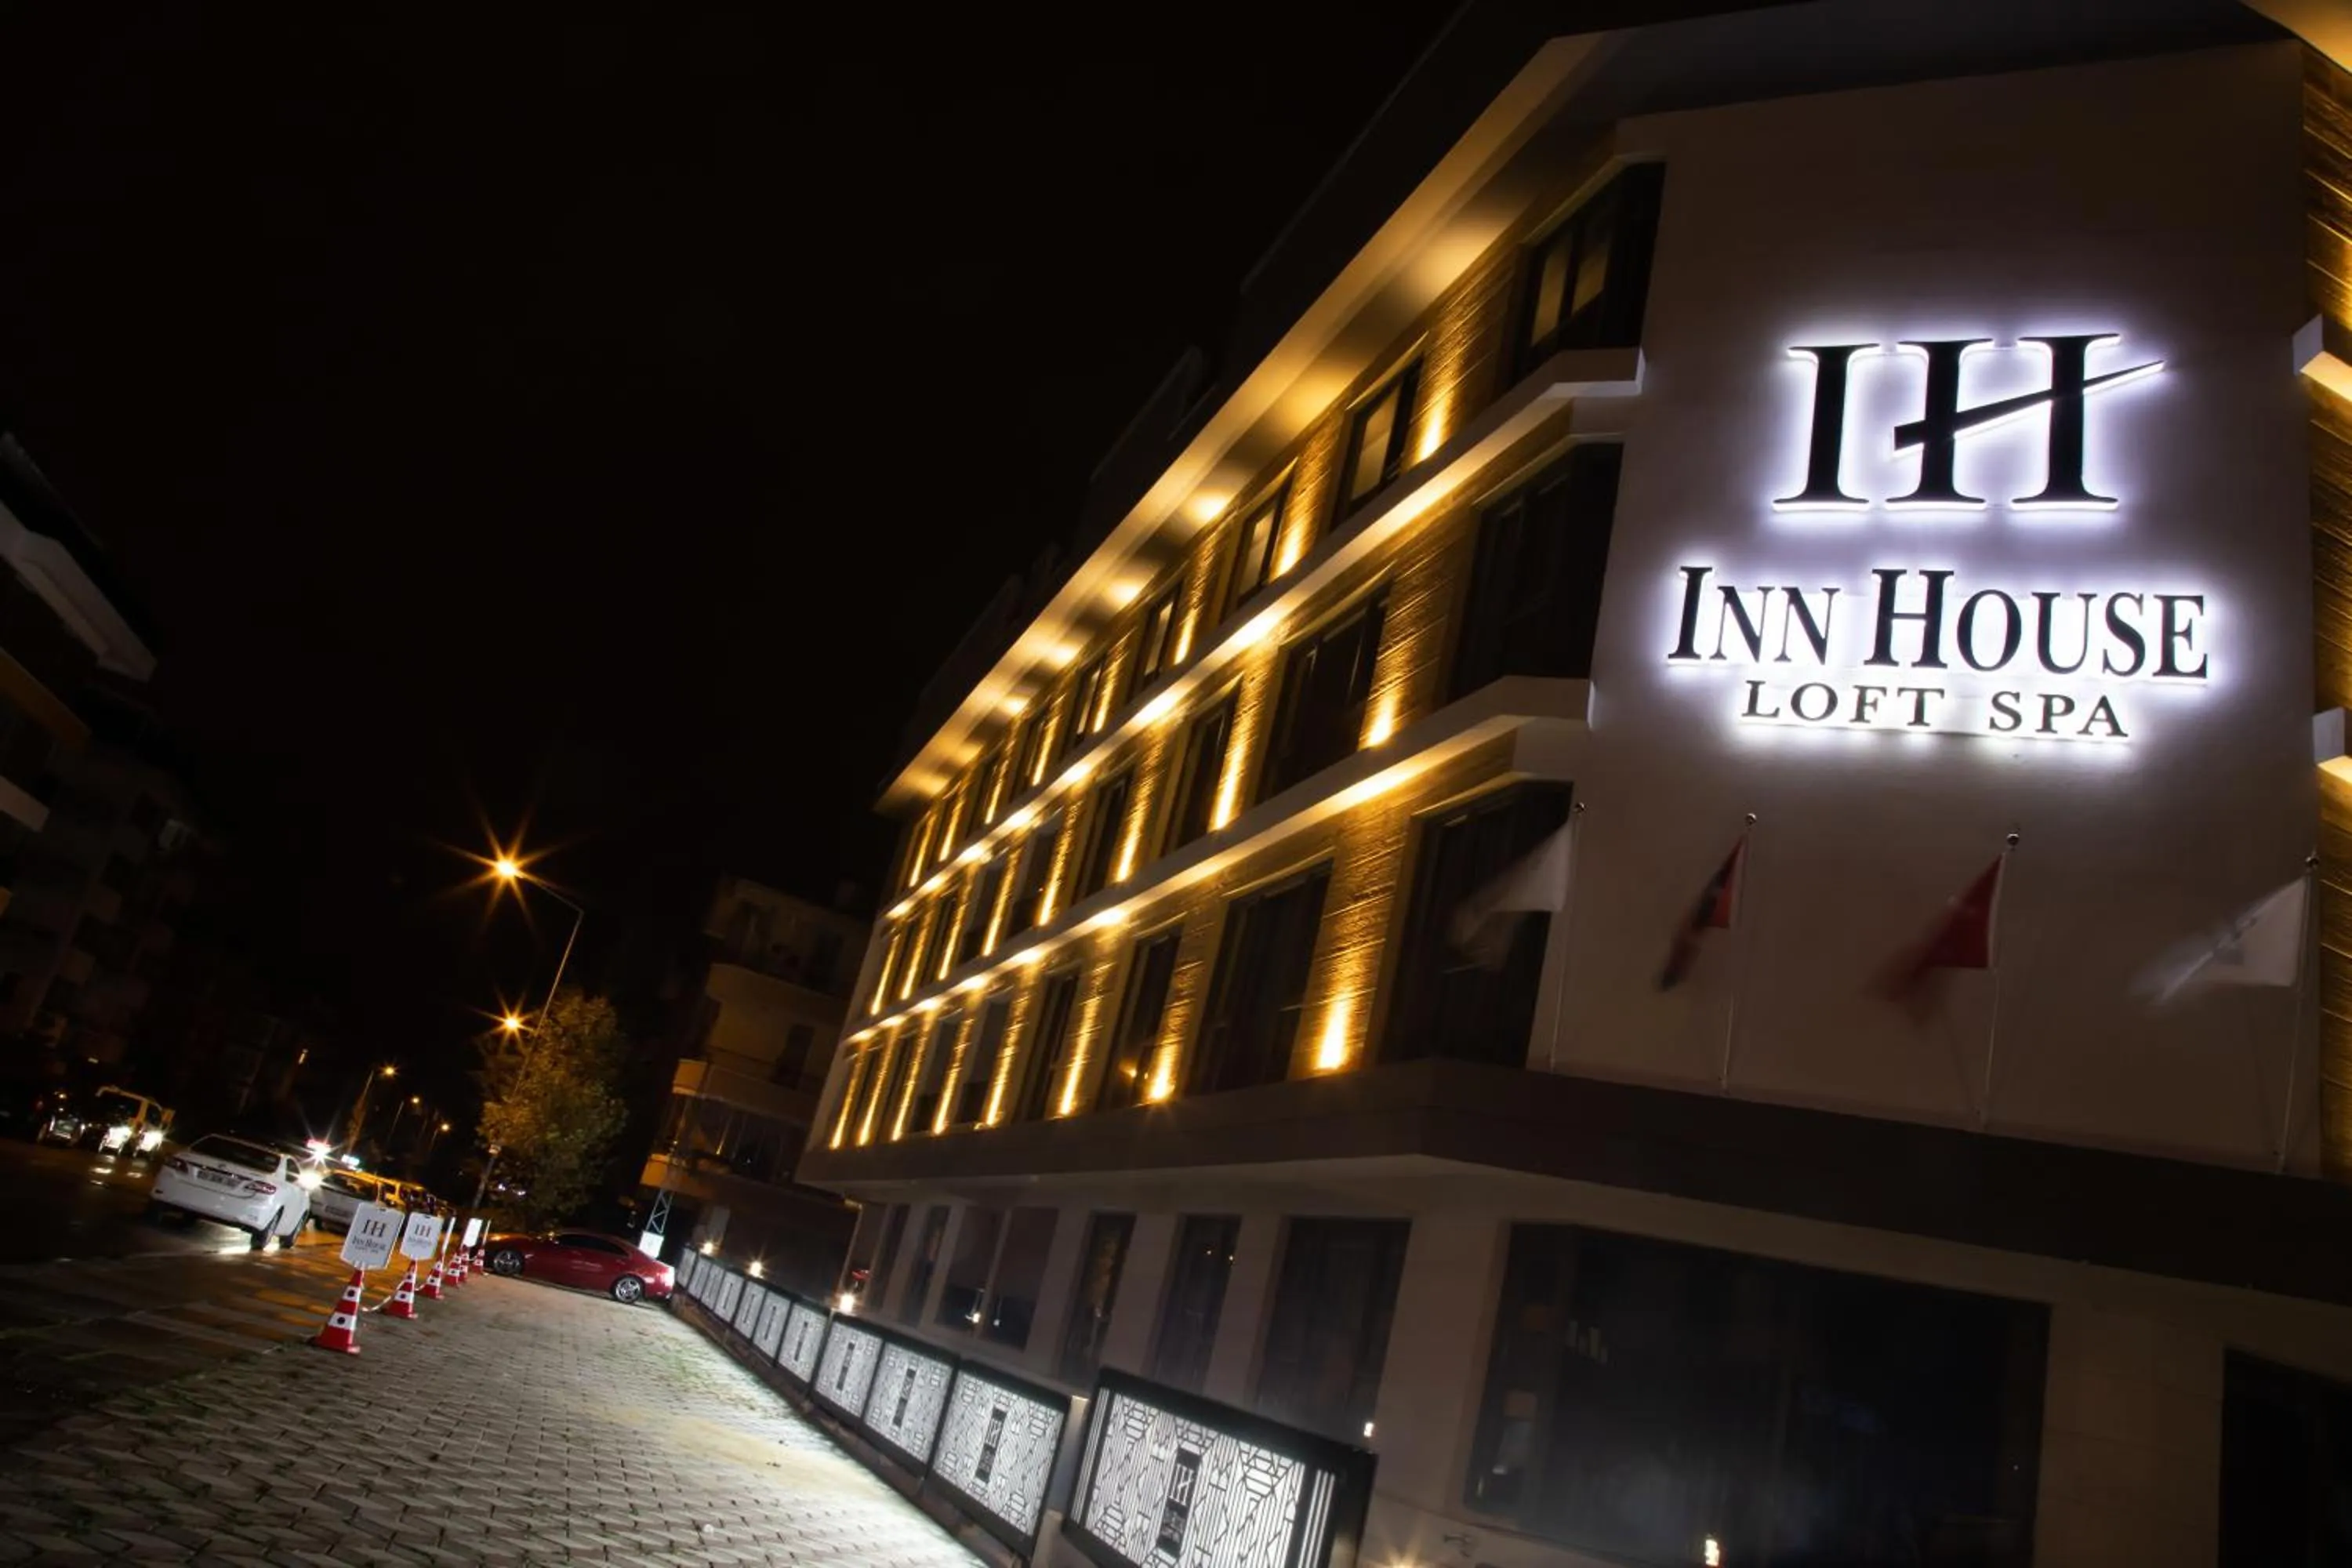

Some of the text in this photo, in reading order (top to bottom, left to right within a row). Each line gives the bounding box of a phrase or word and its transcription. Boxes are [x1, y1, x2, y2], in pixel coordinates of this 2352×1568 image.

[1668, 566, 2209, 680] INN HOUSE
[1741, 680, 2129, 739] LOFT SPA
